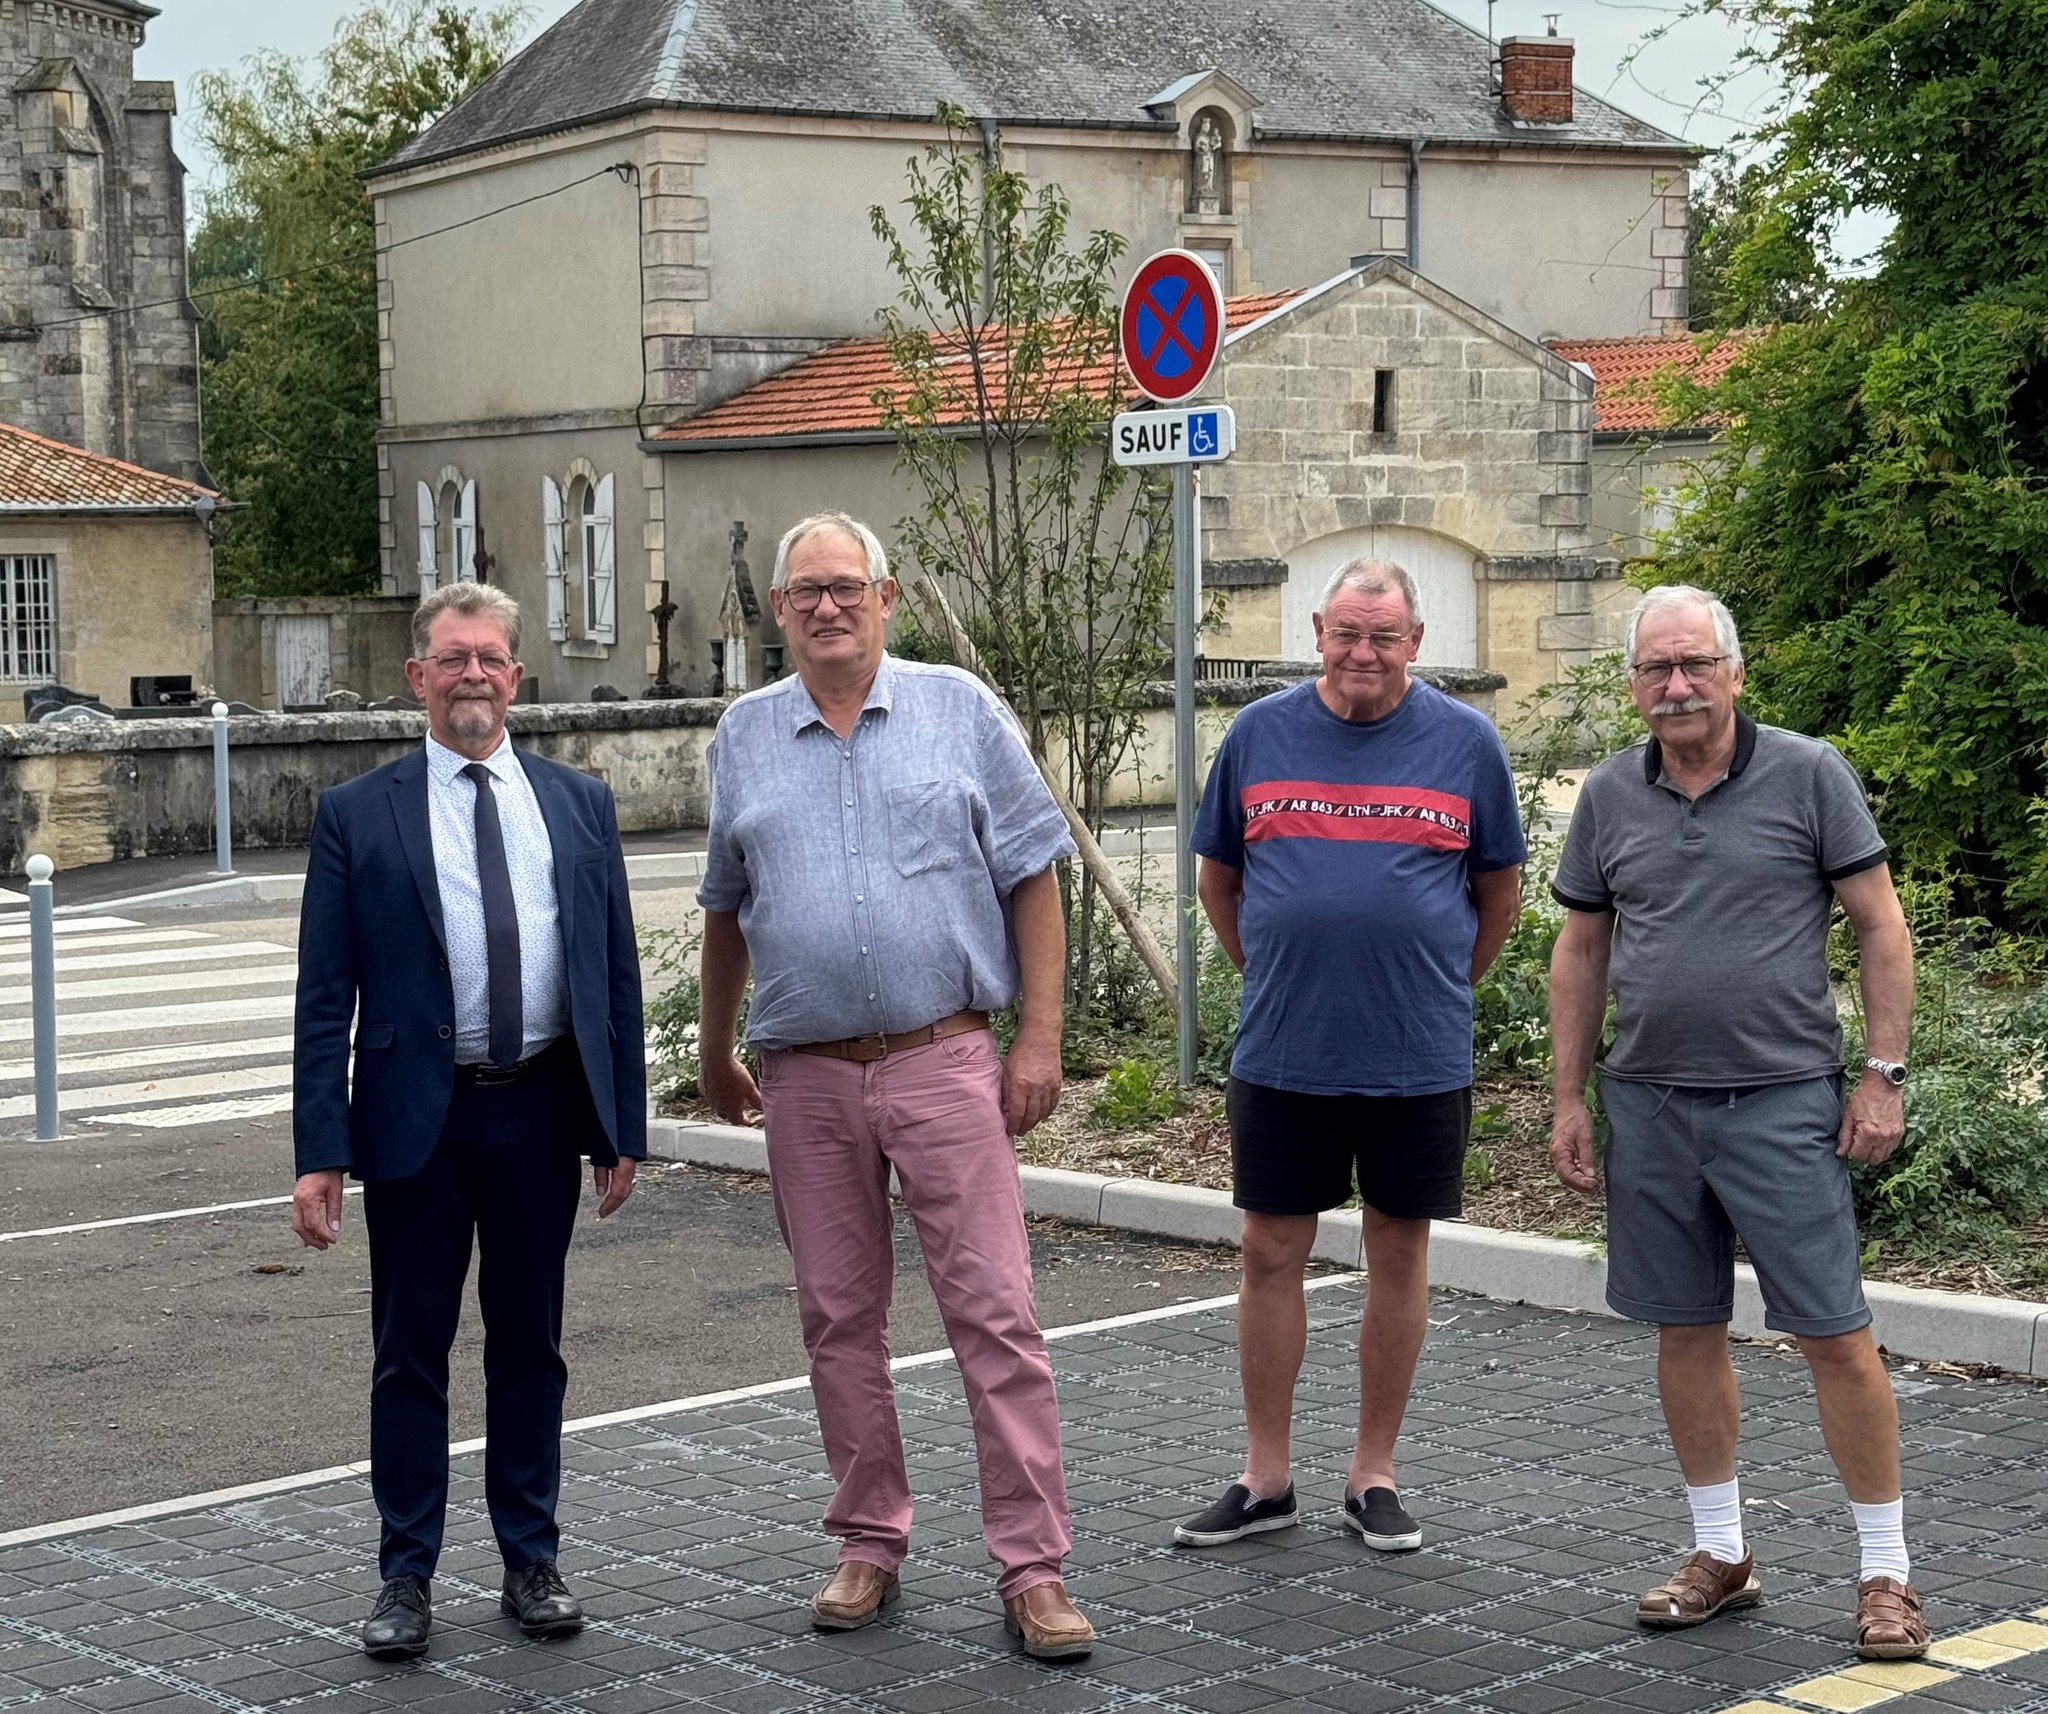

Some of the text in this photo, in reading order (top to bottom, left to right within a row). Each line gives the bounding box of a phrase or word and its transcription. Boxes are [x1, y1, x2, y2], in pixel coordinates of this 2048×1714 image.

[1120, 422, 1182, 454] SAUF
[1257, 800, 1275, 815] JFK
[1290, 799, 1307, 811] AR
[1311, 800, 1333, 814] 863
[1348, 804, 1371, 817] LTN
[1379, 805, 1403, 817] JFK
[1419, 808, 1436, 823] AR
